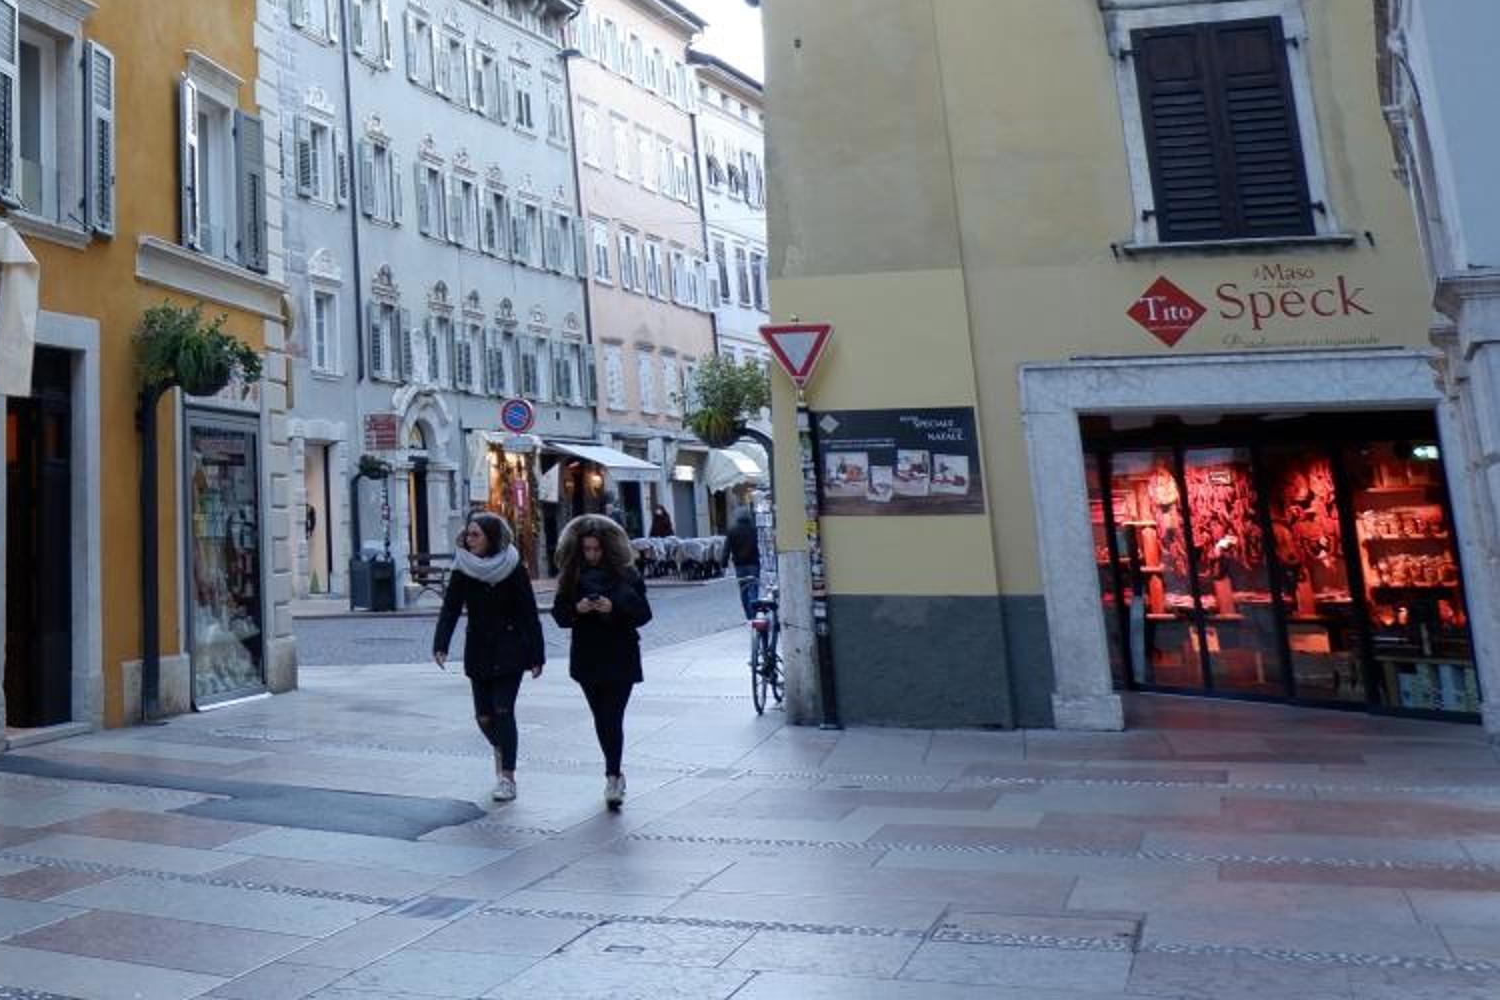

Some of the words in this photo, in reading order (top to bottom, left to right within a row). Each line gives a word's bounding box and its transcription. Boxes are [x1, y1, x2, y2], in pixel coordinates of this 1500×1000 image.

[1262, 263, 1315, 281] Maso
[1139, 295, 1193, 321] Tito
[1216, 275, 1373, 330] Speck
[927, 432, 965, 441] NATALE
